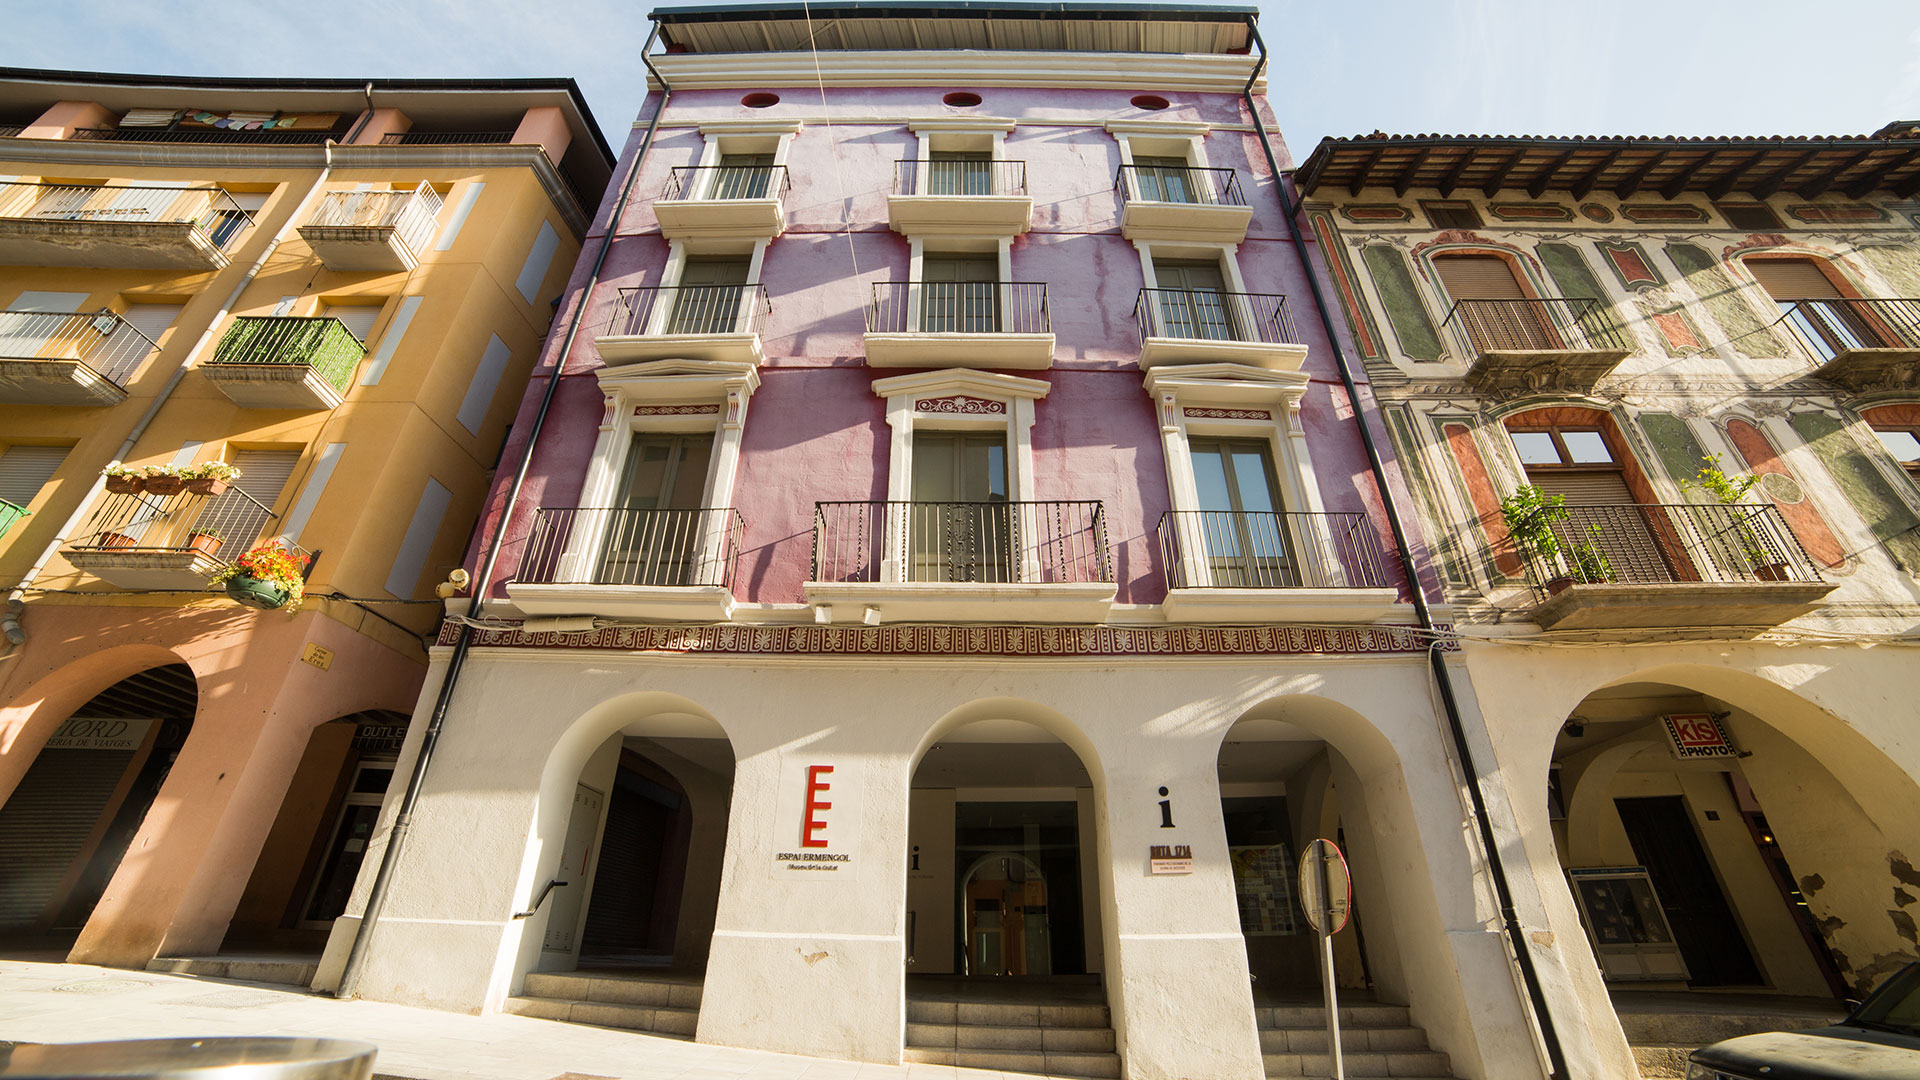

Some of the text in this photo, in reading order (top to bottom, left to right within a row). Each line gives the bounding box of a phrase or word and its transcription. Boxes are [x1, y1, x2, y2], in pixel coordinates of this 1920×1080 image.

[76, 739, 91, 747] DE
[94, 739, 133, 748] VIATGES
[1686, 746, 1729, 756] PHOTO
[1158, 786, 1176, 828] i
[777, 852, 851, 862] ESPAI ERMENGOL
